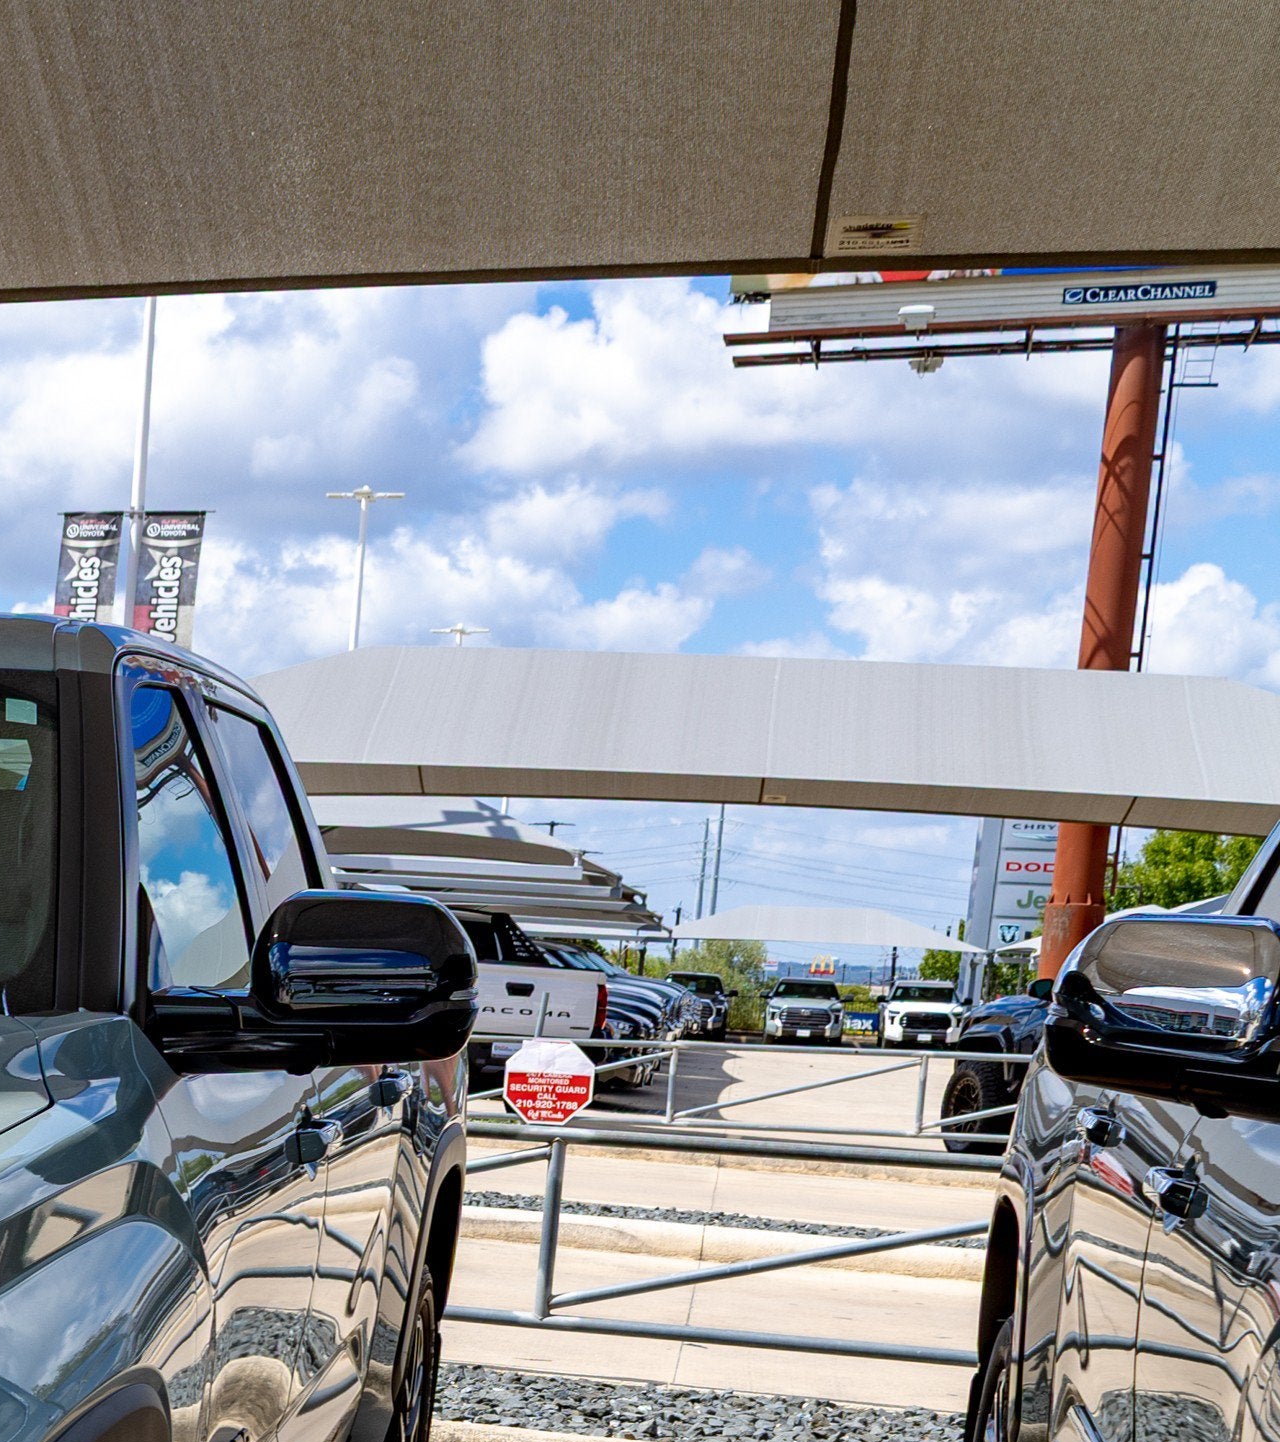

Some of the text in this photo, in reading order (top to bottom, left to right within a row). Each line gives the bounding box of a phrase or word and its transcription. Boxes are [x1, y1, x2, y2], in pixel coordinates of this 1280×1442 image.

[161, 524, 200, 532] UNIVERSAL
[510, 1084, 587, 1094] SECURITY GUARD
[516, 1099, 578, 1110] 210-920-1788
